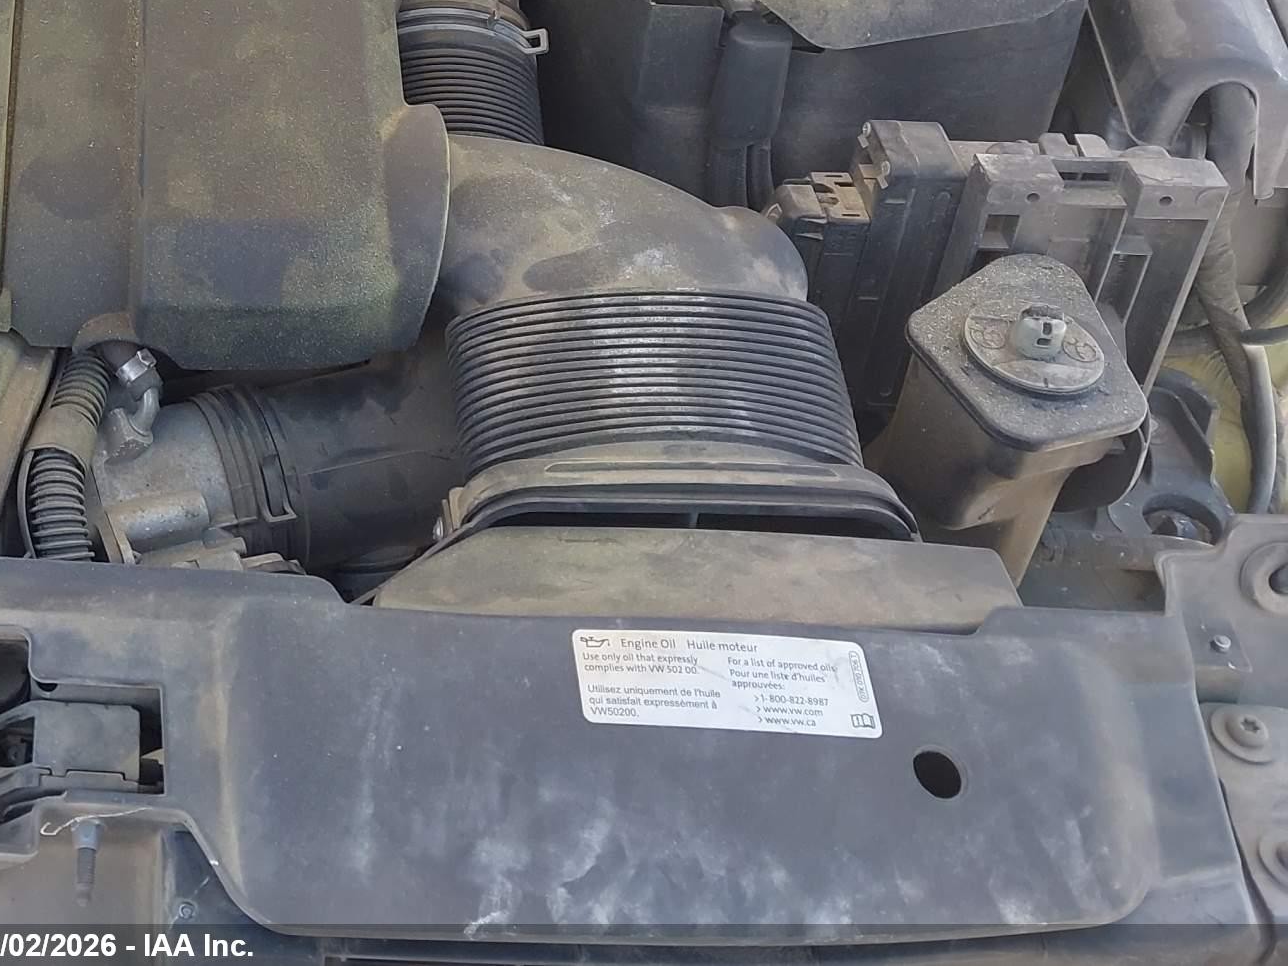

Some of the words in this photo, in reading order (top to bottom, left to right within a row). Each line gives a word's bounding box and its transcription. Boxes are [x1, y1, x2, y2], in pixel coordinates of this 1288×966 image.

[620, 638, 658, 650] Engine
[661, 639, 676, 649] Oil
[687, 639, 716, 650] Huile
[719, 642, 758, 653] moteur
[583, 652, 600, 661] Use
[602, 653, 620, 663] only
[623, 653, 634, 661] oil
[636, 653, 656, 662] that
[658, 654, 698, 666] expressly
[727, 656, 742, 666] For
[751, 657, 764, 667] list
[766, 658, 775, 667] of
[778, 661, 818, 673] approved
[584, 663, 624, 673] complies
[627, 663, 647, 672] with
[648, 664, 665, 673] VW
[667, 665, 683, 674] 502
[729, 669, 750, 678] Pour
[771, 671, 789, 681] liste
[791, 673, 826, 683] d'huiles
[587, 684, 621, 694] Utilisez
[623, 686, 678, 697] uniquement
[681, 687, 693, 696] de
[694, 688, 721, 698] l'huile
[589, 696, 603, 706] qui
[605, 696, 641, 706] satisfait
[763, 706, 823, 716] www.vw.com
[765, 717, 816, 727] www.vw.ca
